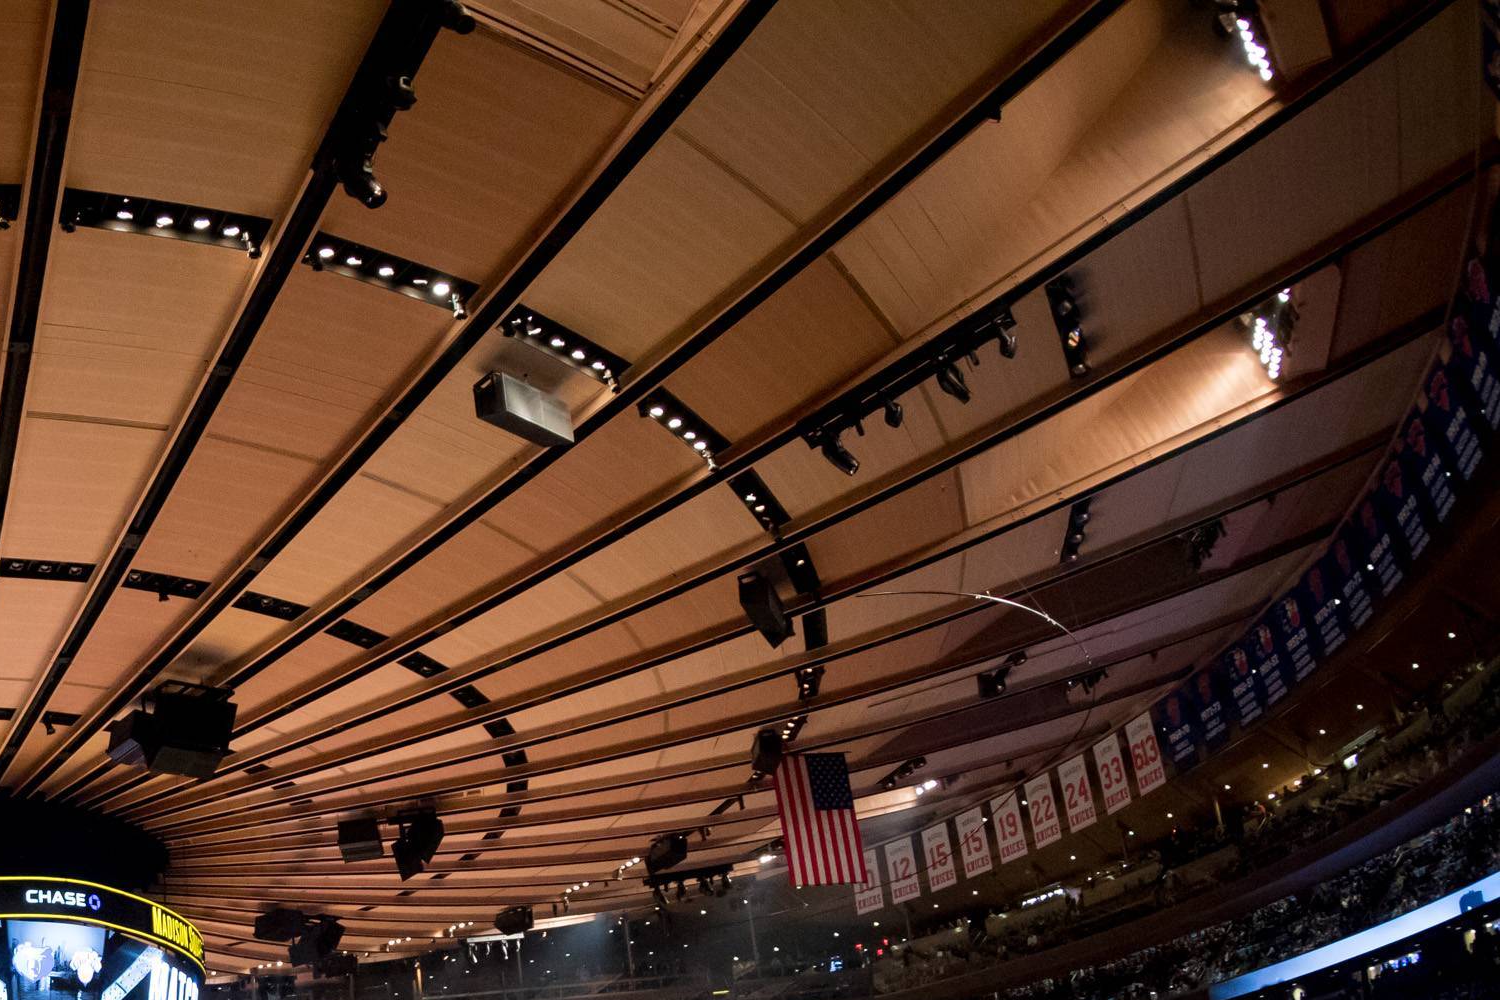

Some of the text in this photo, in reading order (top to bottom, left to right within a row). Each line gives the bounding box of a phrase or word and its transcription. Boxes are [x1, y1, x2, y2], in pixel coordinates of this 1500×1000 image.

[1131, 735, 1158, 770] 613
[1101, 757, 1123, 789] 33
[1139, 767, 1162, 789] KNICKS
[1065, 776, 1088, 809] 24
[1106, 787, 1129, 808] KNICKS
[1031, 795, 1054, 826] 22
[1070, 806, 1093, 826] KNICKS
[999, 812, 1018, 841] 19
[1035, 823, 1059, 842] KNICKS
[1001, 840, 1025, 858] KNICKS
[892, 857, 911, 880] 12
[966, 856, 990, 873] KNICKS
[931, 870, 954, 887] KNICKS
[25, 889, 87, 907] CHASE
[857, 894, 881, 908] KNICKS
[894, 882, 918, 899] KNICKS
[151, 905, 189, 950] MADISON
